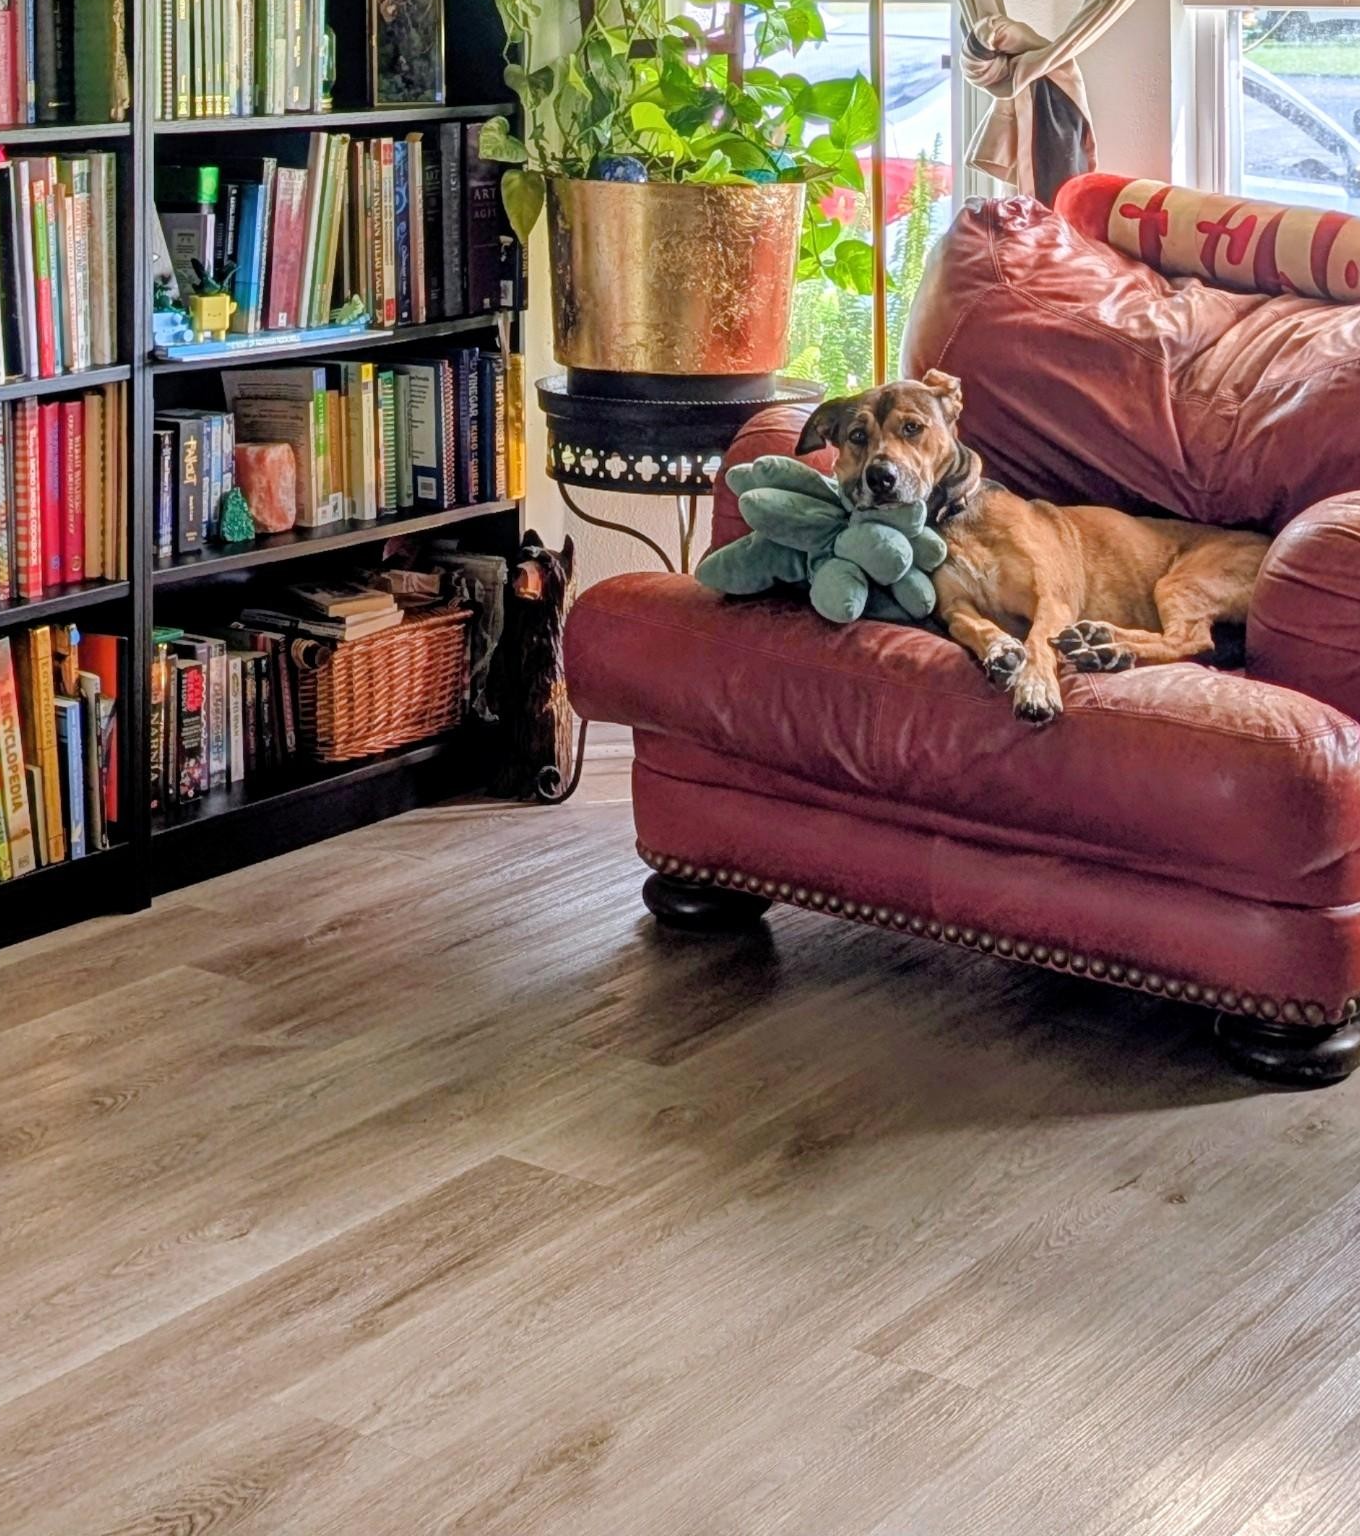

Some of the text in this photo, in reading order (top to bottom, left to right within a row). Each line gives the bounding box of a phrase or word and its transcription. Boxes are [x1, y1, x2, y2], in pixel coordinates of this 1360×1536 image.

[474, 188, 496, 199] ART
[372, 191, 383, 301] INDIAN HERITAGE
[469, 372, 478, 417] VINEGAR
[496, 376, 505, 497] FIX-IT-YOURSELF MANUAL
[0, 692, 24, 813] ENCYCLOPEDIA
[150, 712, 159, 781] NARNIA
